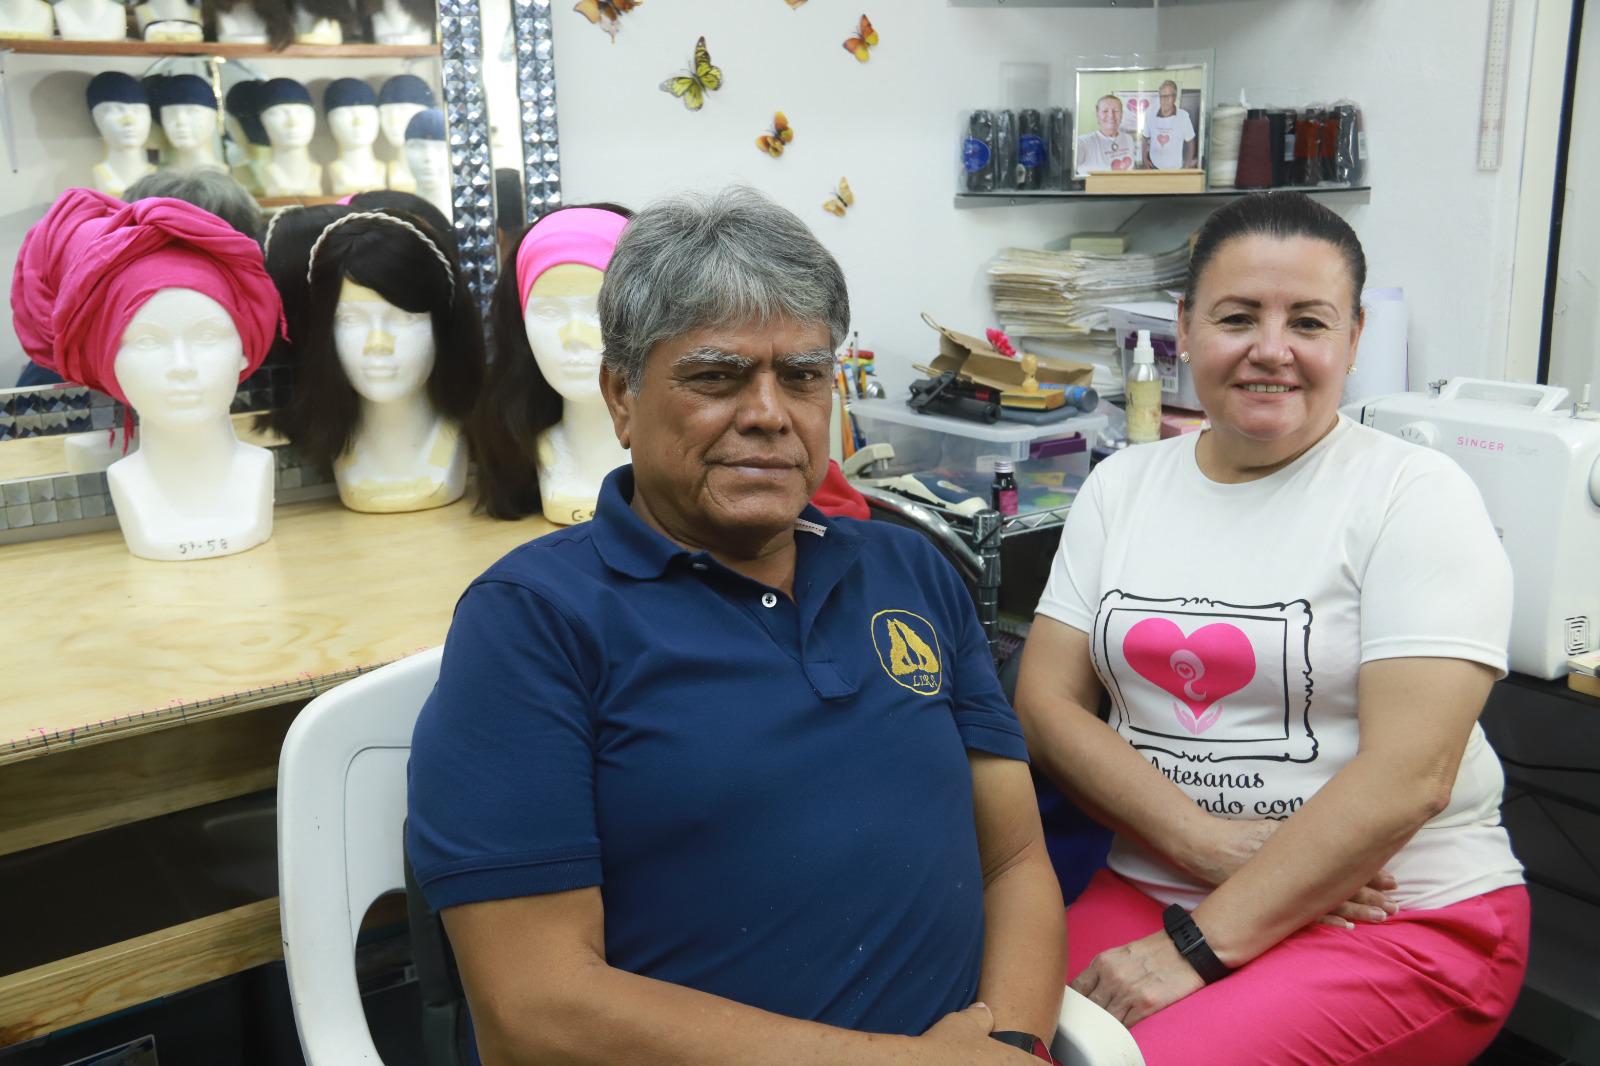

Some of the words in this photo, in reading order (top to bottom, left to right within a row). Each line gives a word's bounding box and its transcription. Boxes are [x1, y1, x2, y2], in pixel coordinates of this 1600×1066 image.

[1457, 436, 1505, 451] SINGER
[1196, 792, 1245, 815] ndo
[1254, 796, 1304, 815] con
